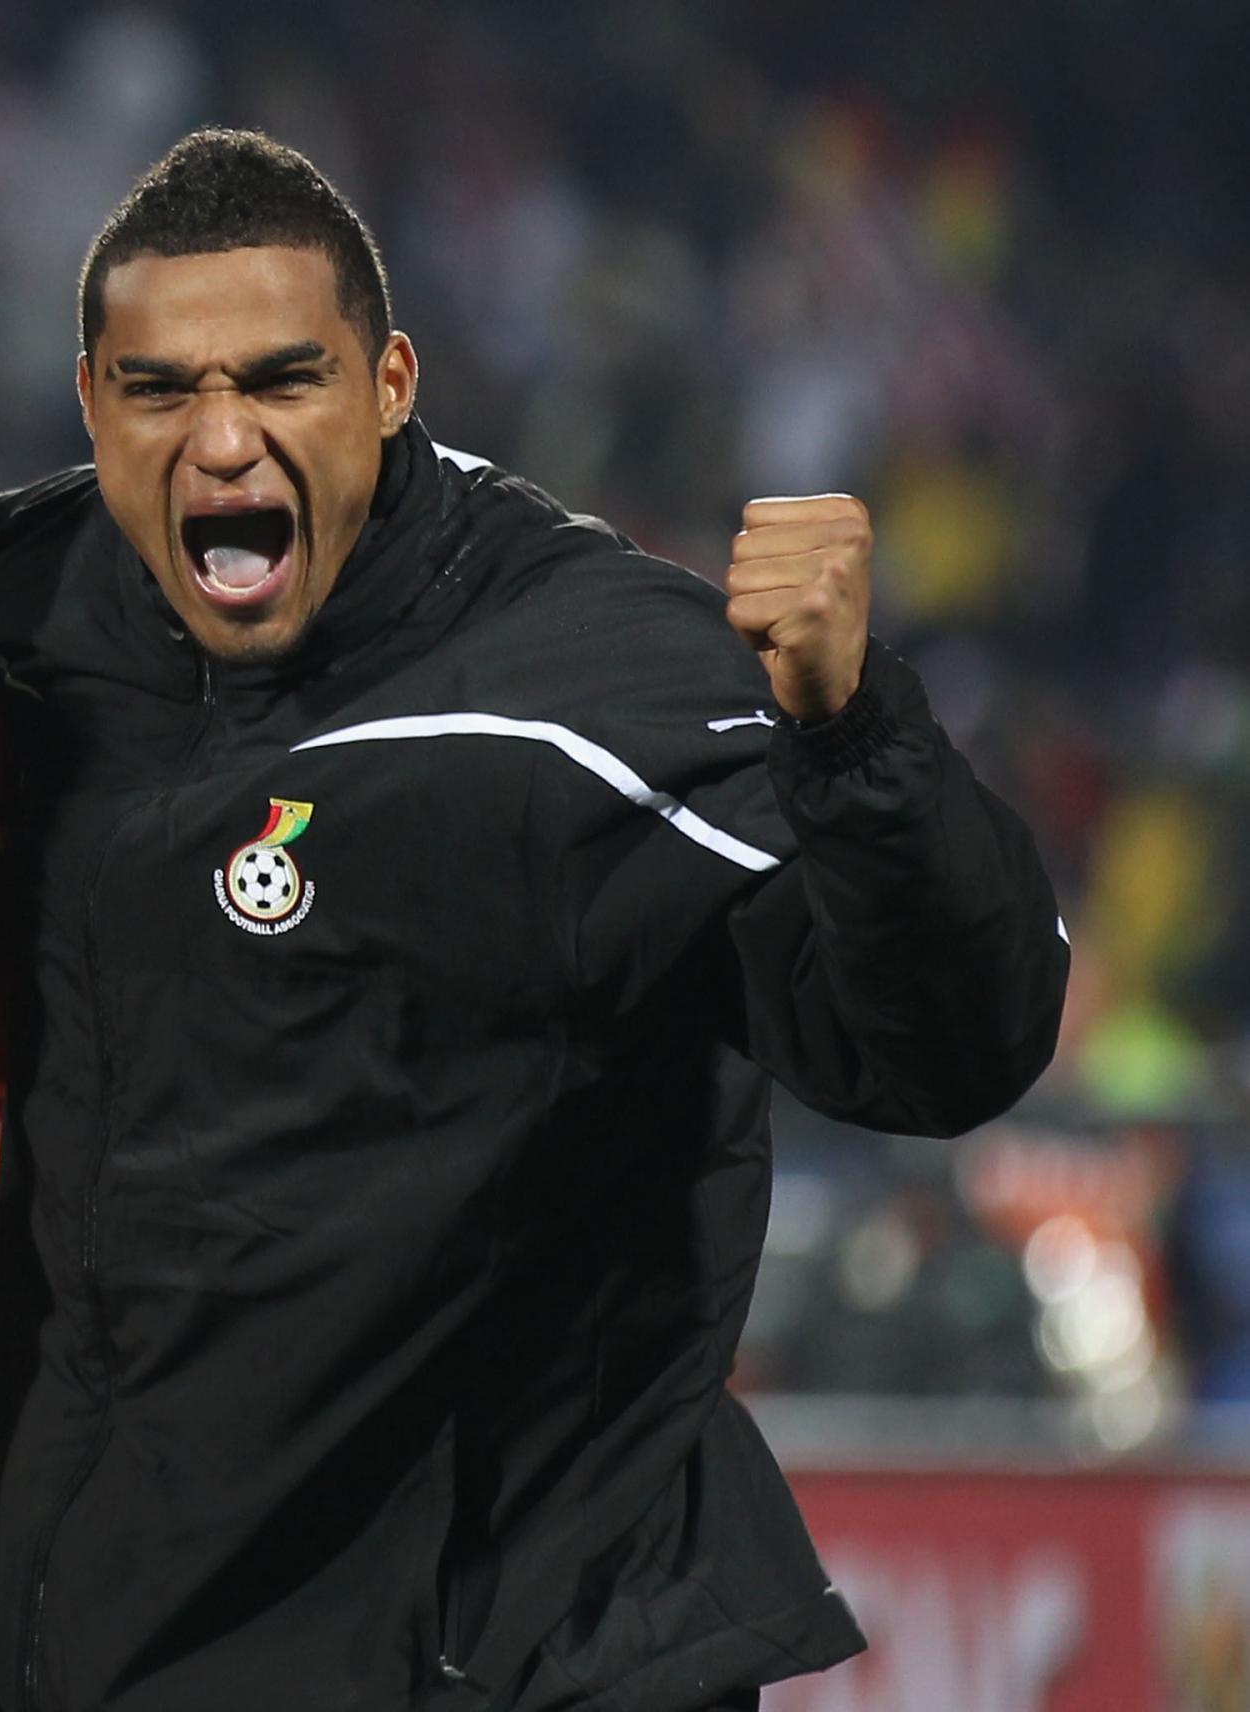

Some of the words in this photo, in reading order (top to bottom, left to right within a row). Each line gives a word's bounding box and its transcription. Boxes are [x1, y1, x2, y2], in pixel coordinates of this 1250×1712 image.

[213, 868, 229, 909] GHANA
[224, 905, 273, 935] FOOTBALL
[274, 880, 315, 935] ASSOCIATION
